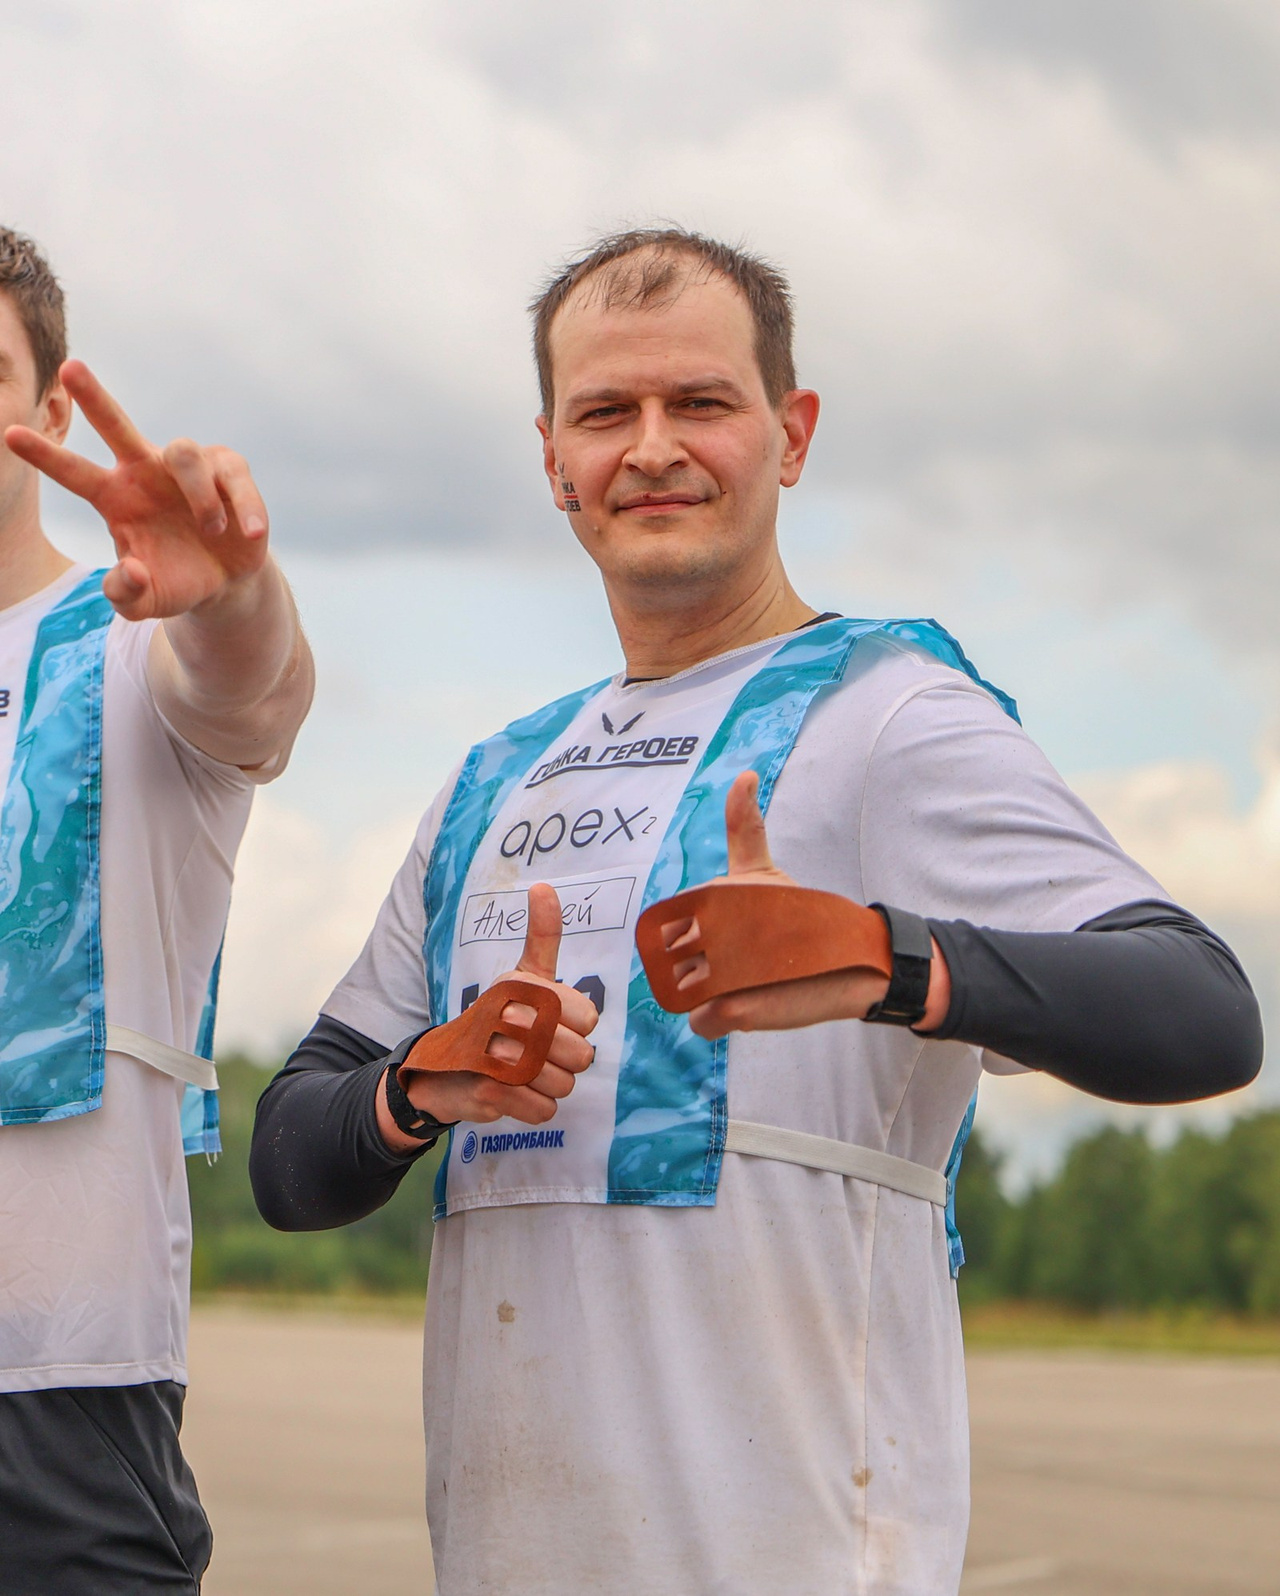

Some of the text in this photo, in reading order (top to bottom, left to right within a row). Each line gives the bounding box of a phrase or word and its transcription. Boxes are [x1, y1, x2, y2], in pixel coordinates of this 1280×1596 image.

[530, 735, 700, 782] ГОНКА ГЕРОЕВ
[473, 885, 602, 938] Алеей
[480, 1129, 564, 1154] ГАЗПРОМБАНК
